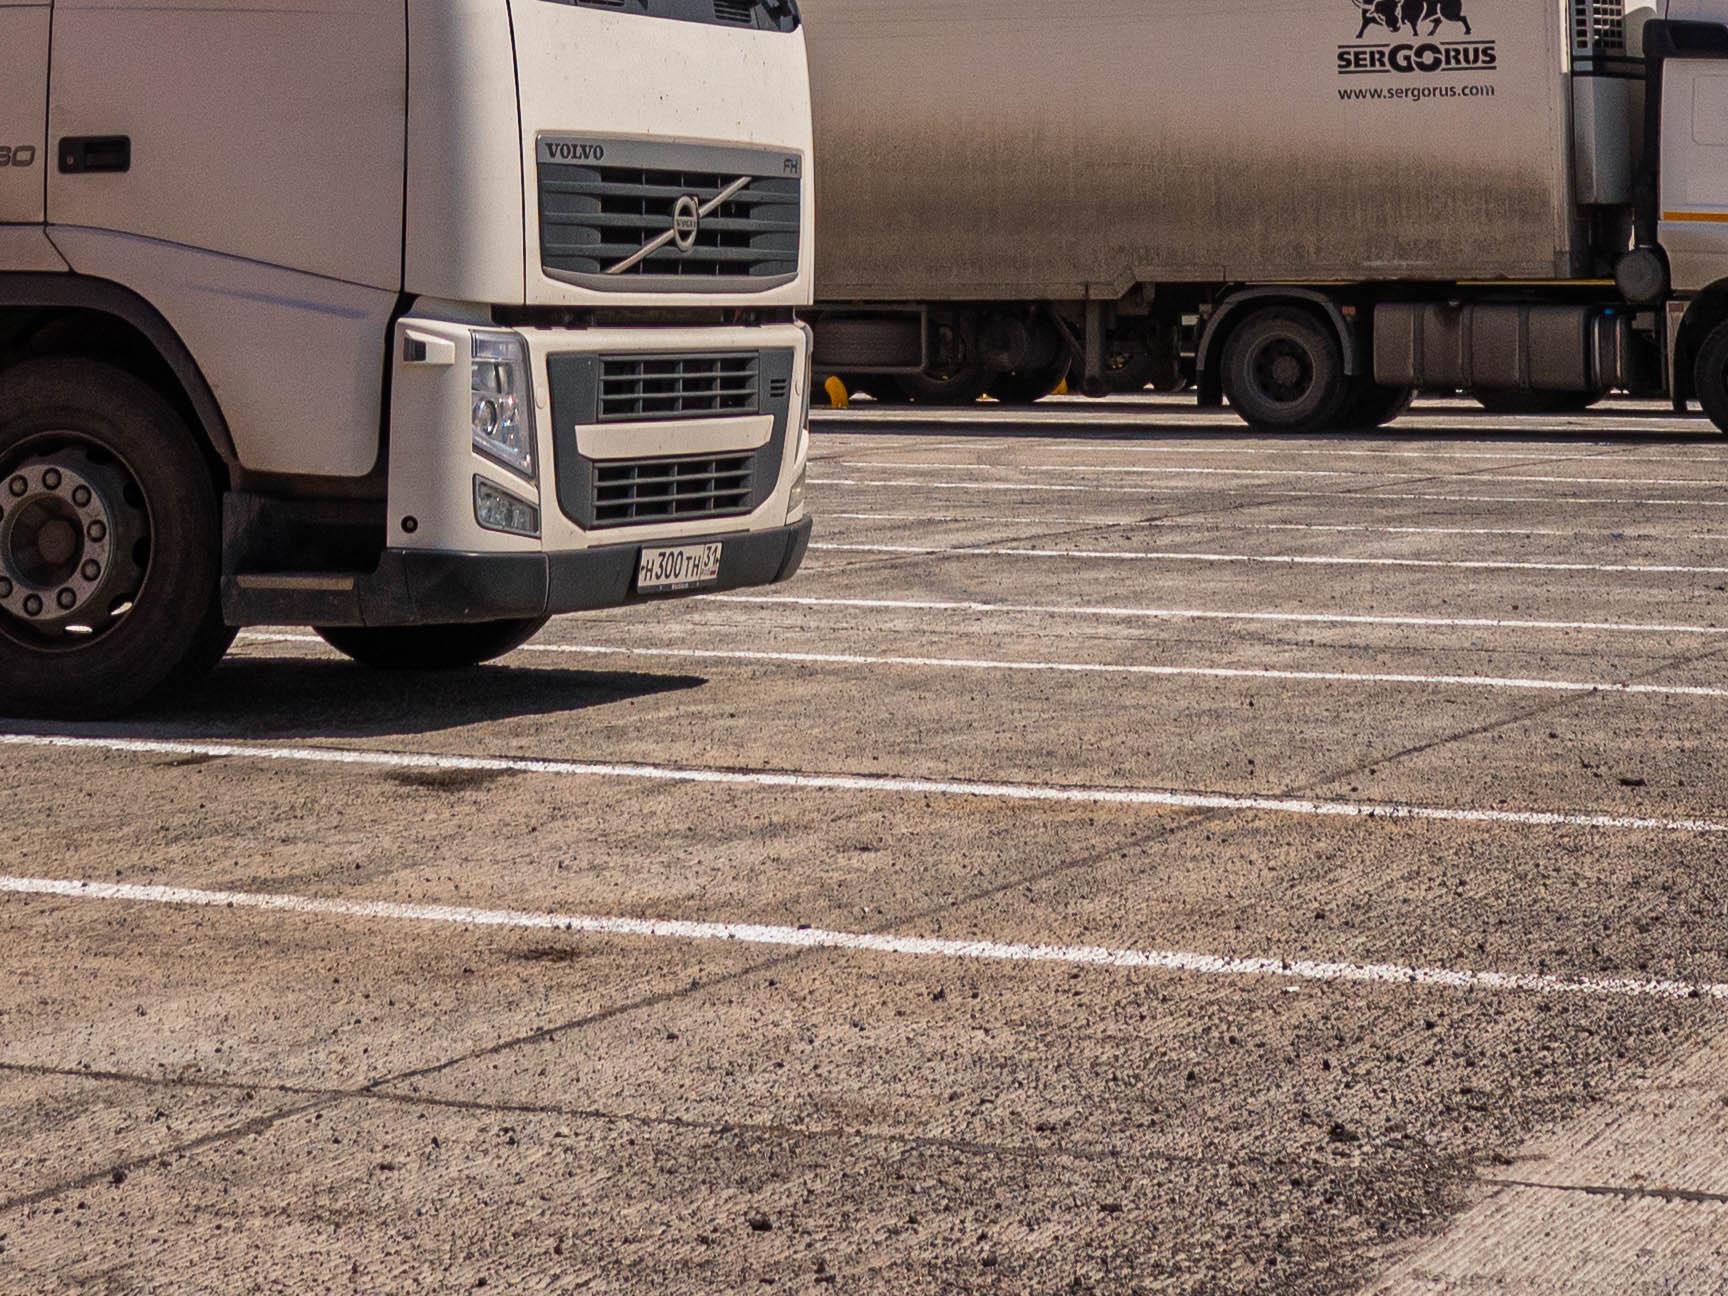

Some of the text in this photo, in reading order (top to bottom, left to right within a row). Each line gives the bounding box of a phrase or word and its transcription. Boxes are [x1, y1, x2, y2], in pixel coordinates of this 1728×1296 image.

[1337, 84, 1495, 102] www.sergorus.com
[544, 142, 605, 161] VOLVO
[783, 158, 799, 174] FH
